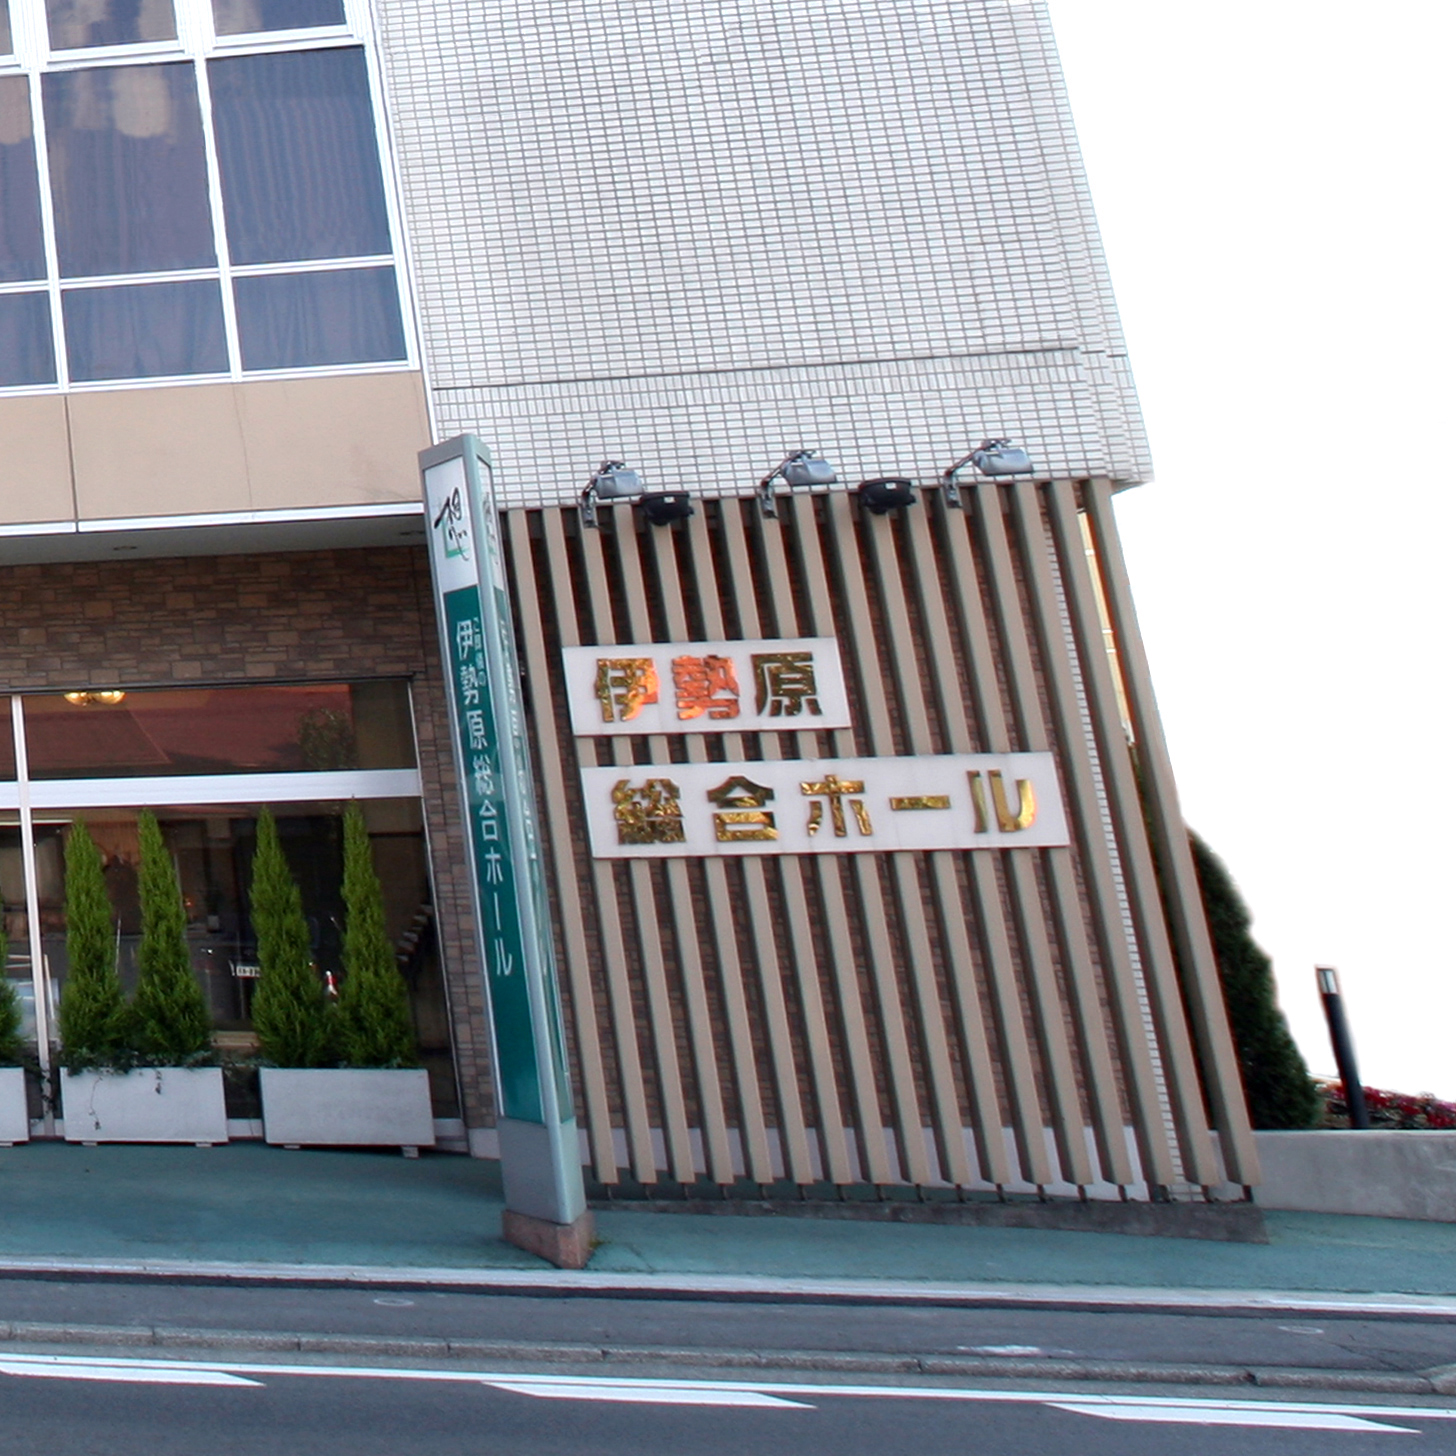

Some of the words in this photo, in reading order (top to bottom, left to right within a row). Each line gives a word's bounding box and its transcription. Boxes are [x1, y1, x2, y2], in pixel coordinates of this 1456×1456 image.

[592, 652, 823, 723] 伊勢原
[456, 619, 513, 976] 伊勢原総合ホール
[612, 769, 1038, 846] 総合ホール
